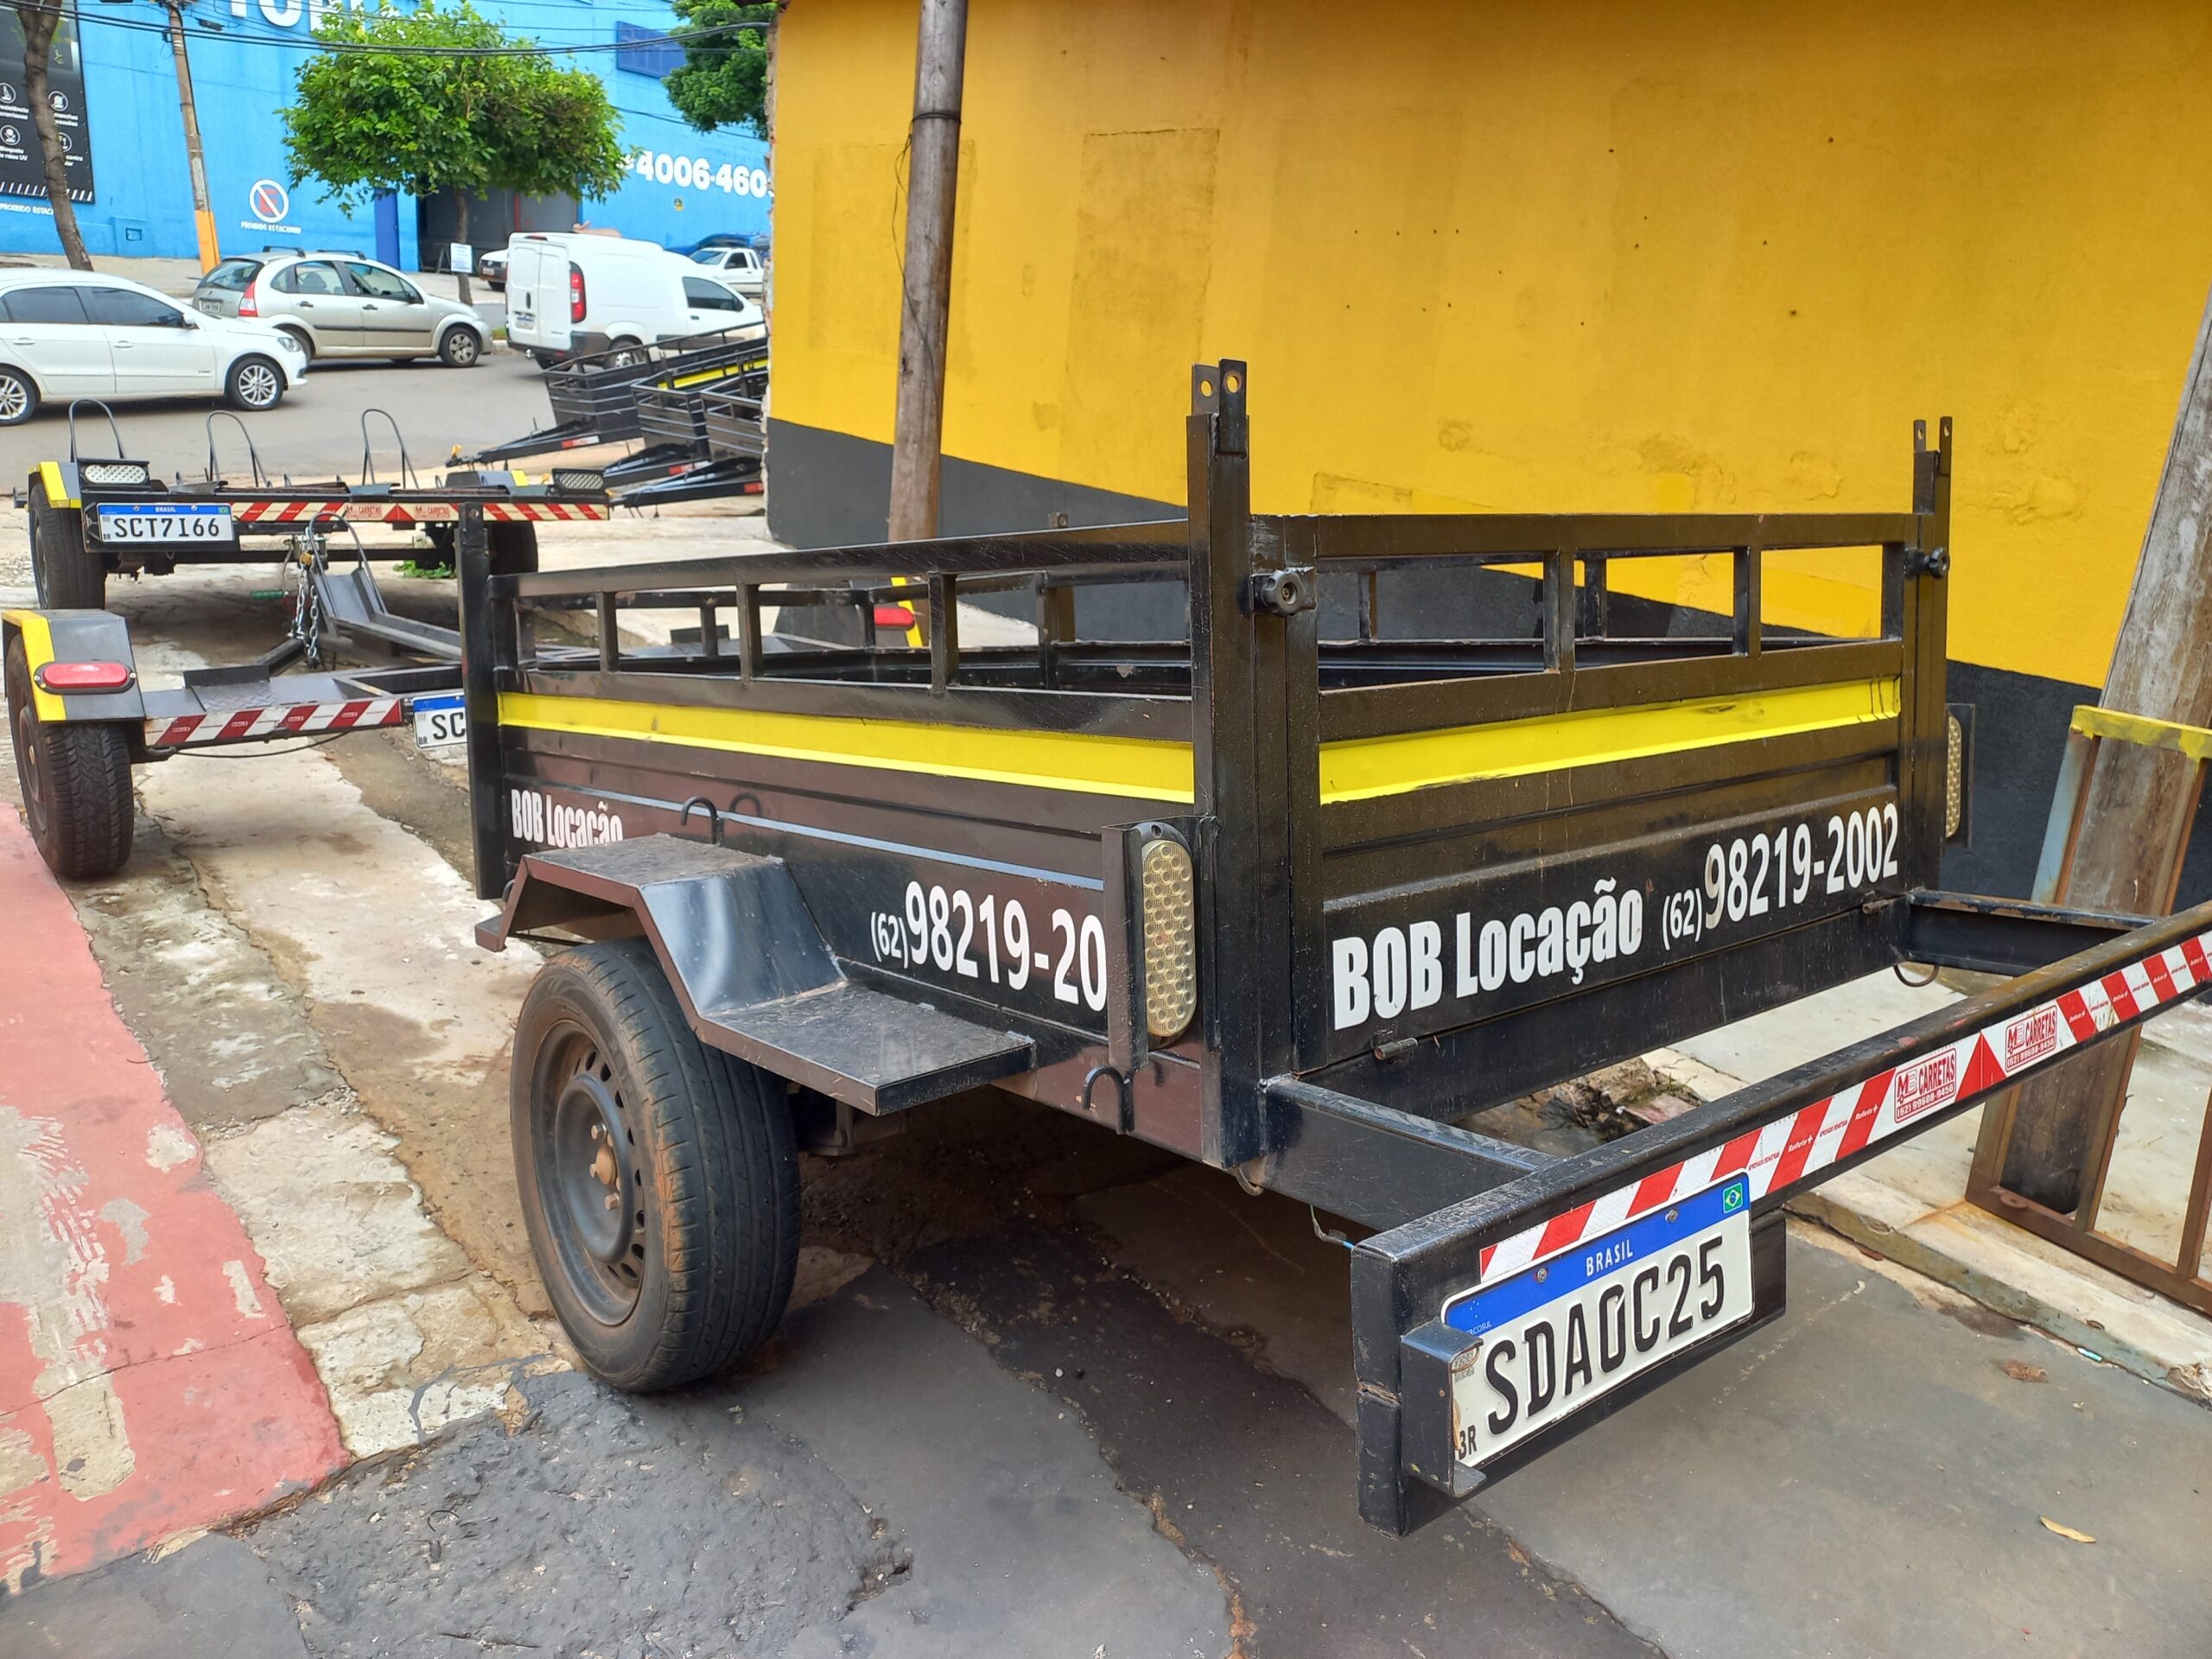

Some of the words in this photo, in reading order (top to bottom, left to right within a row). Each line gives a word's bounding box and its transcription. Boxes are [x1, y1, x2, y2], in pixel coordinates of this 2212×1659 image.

[113, 518, 219, 537] SCT7166
[431, 712, 466, 741] SC
[511, 789, 544, 843] BOB
[1332, 920, 1442, 1031] BOB
[1455, 877, 1643, 999] Locação
[2025, 1010, 2056, 1046] CARRETAS
[1919, 1054, 1955, 1095] CARRETAS
[1586, 1239, 1633, 1277] BRASIL
[1466, 1320, 1492, 1336] RCOSUL
